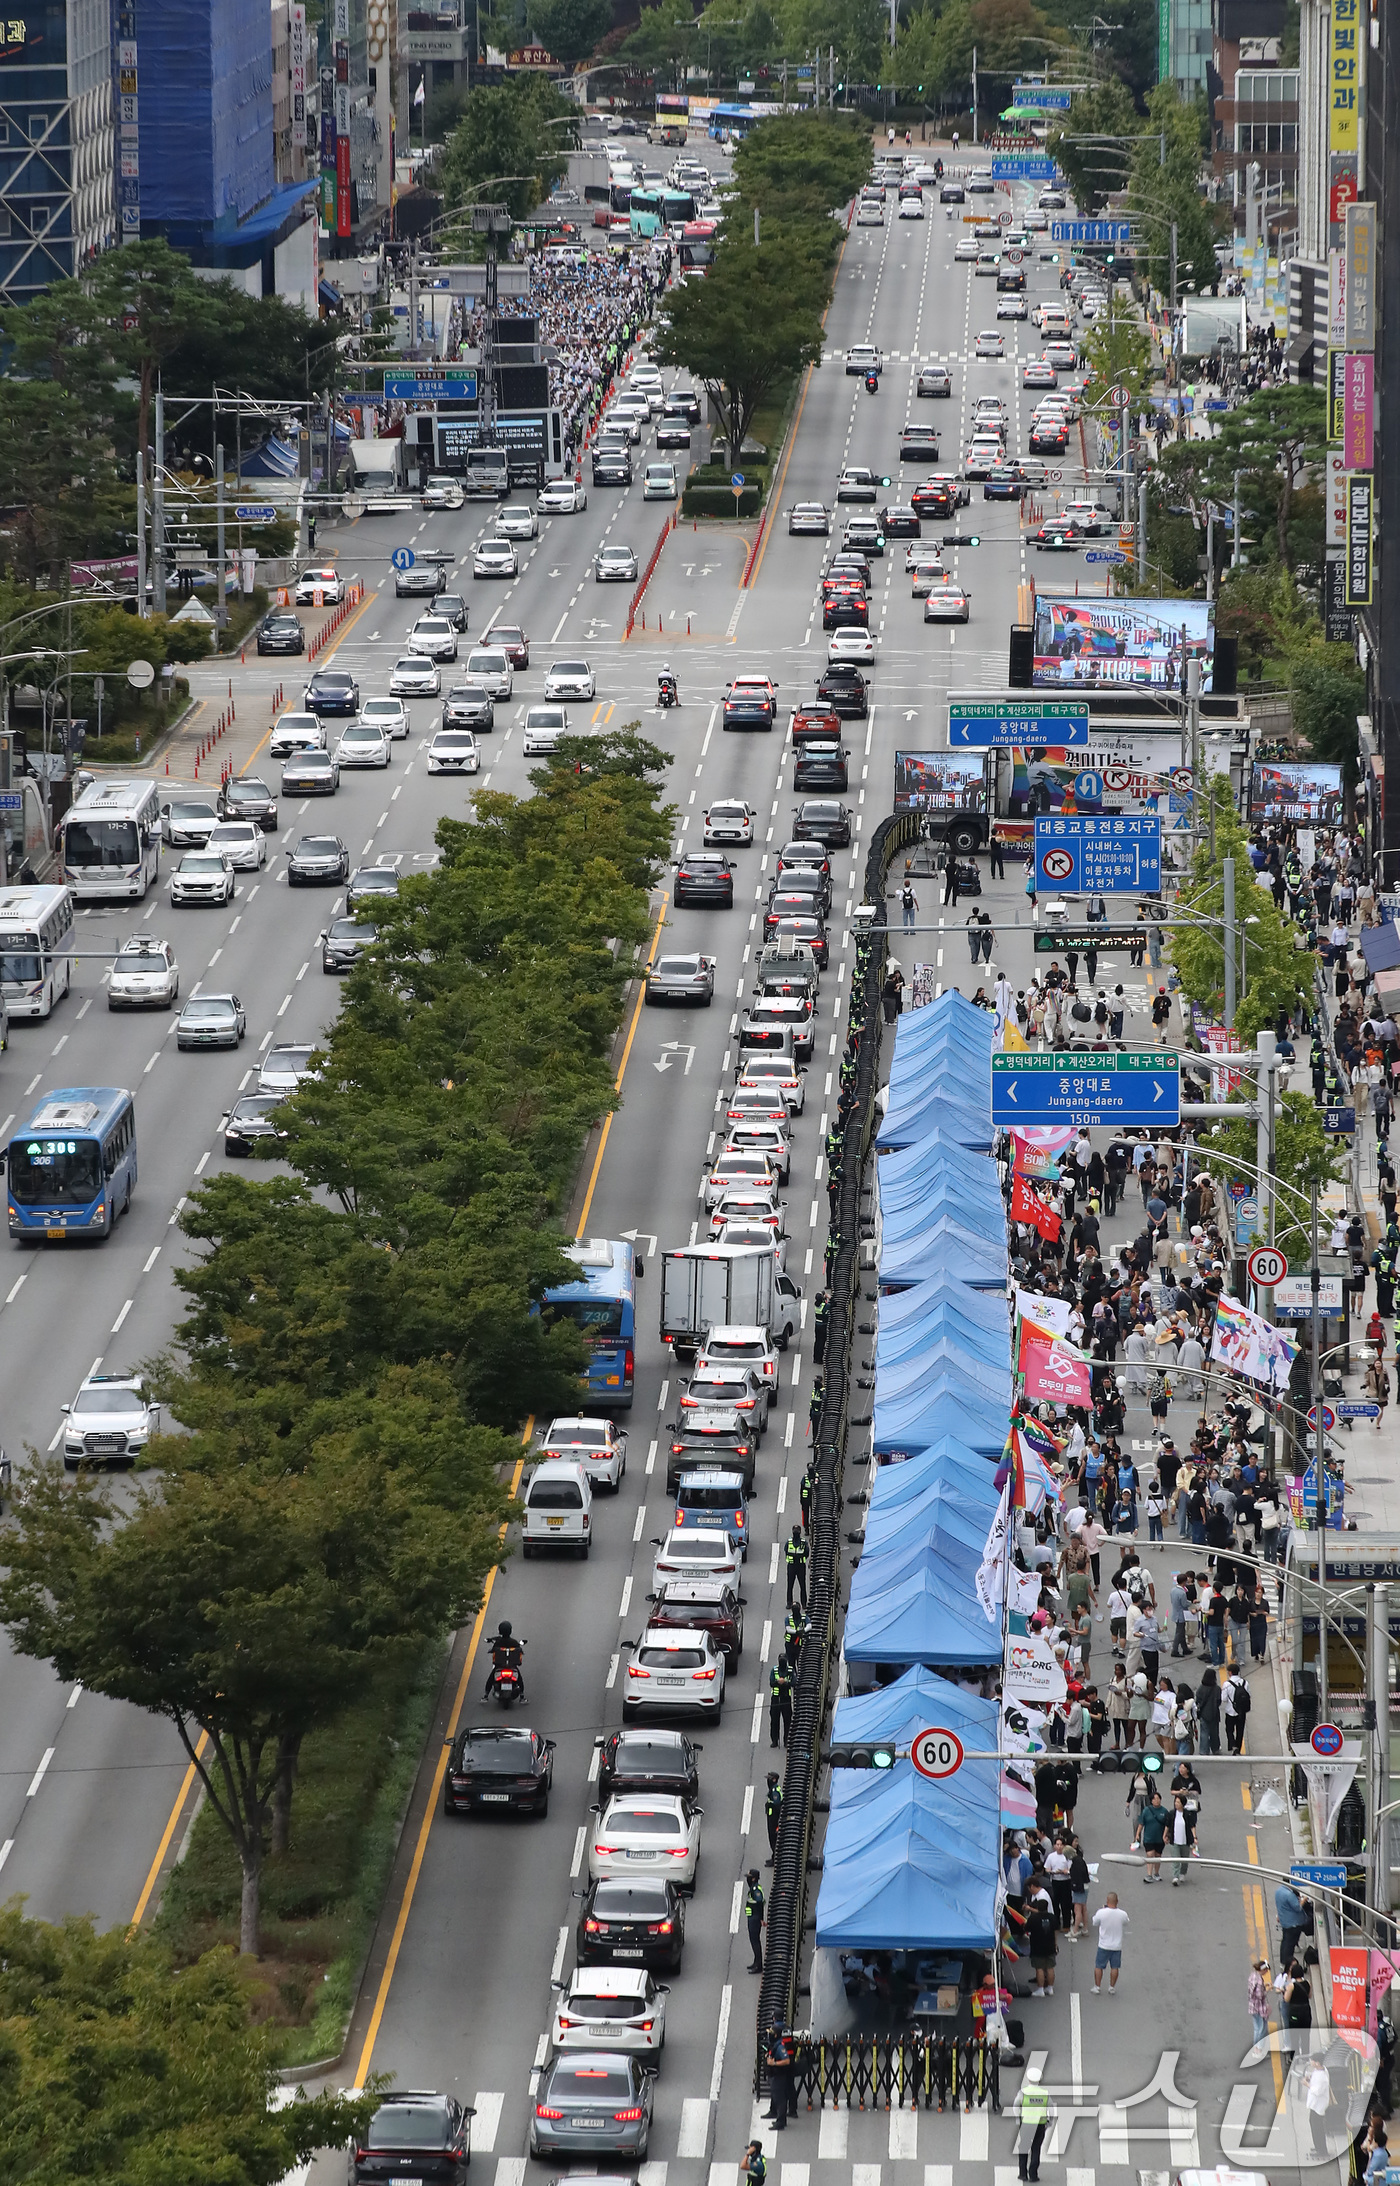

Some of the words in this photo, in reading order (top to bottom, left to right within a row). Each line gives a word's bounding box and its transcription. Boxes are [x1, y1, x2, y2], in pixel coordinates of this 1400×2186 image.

[1333, 0, 1357, 109] 한빛안과
[1338, 122, 1350, 131] 3F
[1333, 631, 1346, 640] 5F
[960, 706, 994, 716] 명덕네거리
[1006, 706, 1041, 716] 계산오거리
[1051, 706, 1078, 716] 대구역
[999, 721, 1039, 734] 중앙대로
[991, 735, 1048, 744] Jungang-daero
[1039, 820, 1156, 835] 대중교통전용지구
[1085, 841, 1123, 851] 시내버스
[1085, 865, 1132, 876] 이륜자동차
[1140, 858, 1159, 869] 허용
[1085, 877, 1114, 888] 자전거
[1006, 1056, 1051, 1068] 명덕네거리
[1068, 1056, 1115, 1069] 계산오거리
[1129, 1056, 1165, 1068] 대구역
[1058, 1077, 1112, 1095] 중앙대로
[1047, 1096, 1124, 1108] Jungang-daero
[1070, 1113, 1101, 1124] 150m
[46, 1141, 76, 1154] 306
[33, 1156, 51, 1165] 306
[1257, 1257, 1278, 1276] 60
[584, 1311, 610, 1322] 730
[1038, 1378, 1064, 1391] 모두의
[1065, 1383, 1083, 1396] 결혼
[1333, 1563, 1376, 1576] 반월당
[923, 1741, 951, 1765] 60
[1339, 1965, 1359, 1977] ART
[1332, 1974, 1366, 1987] DAEGU
